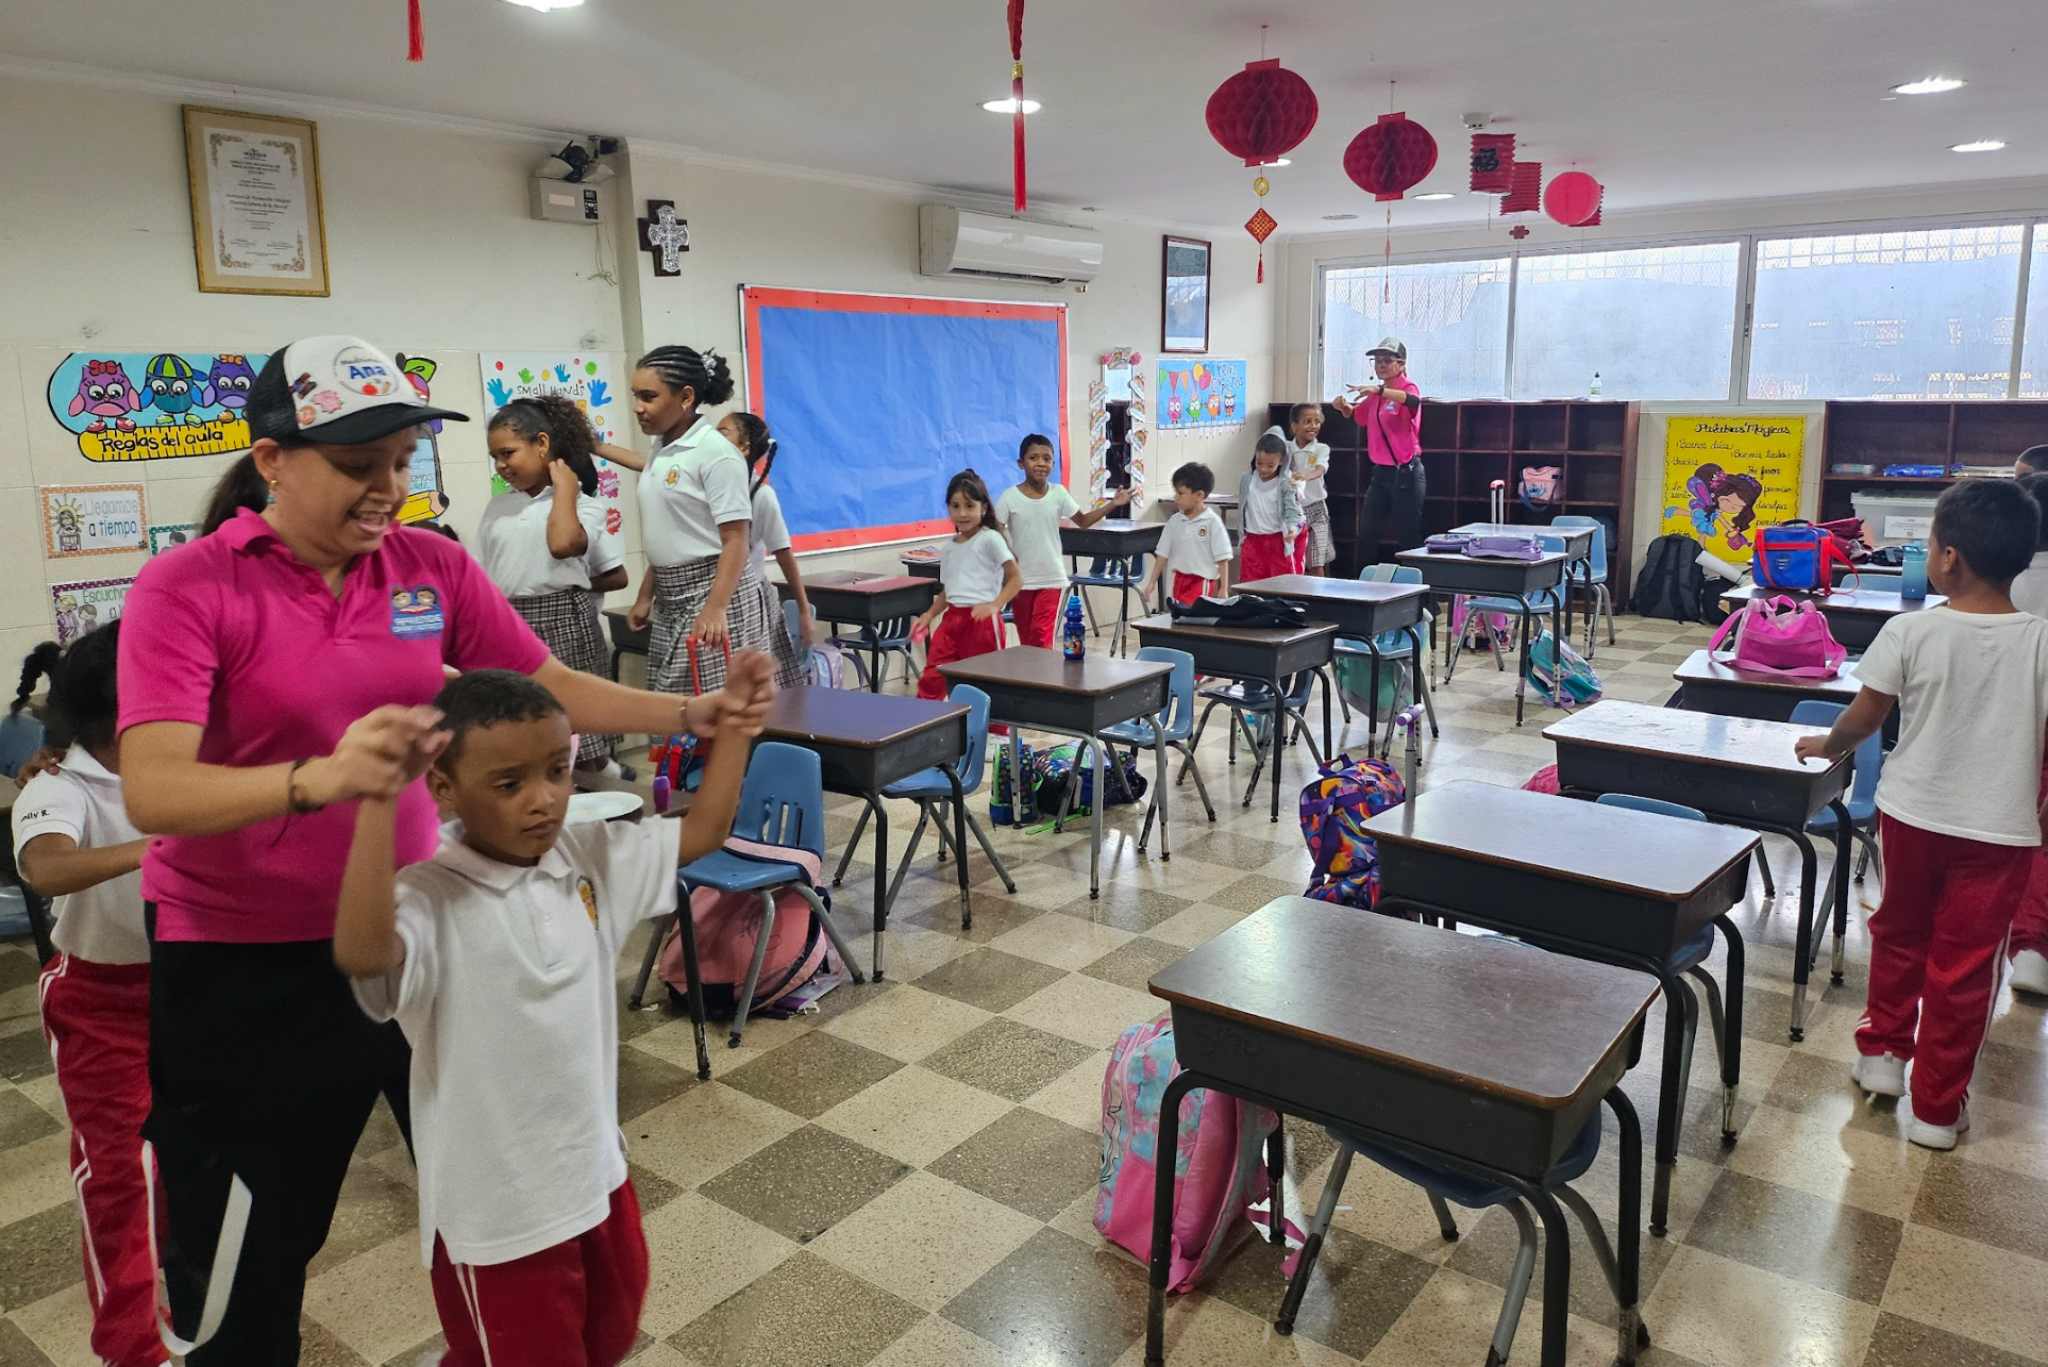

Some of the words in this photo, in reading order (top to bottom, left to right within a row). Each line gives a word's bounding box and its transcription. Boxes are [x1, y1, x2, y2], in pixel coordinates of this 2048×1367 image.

[350, 365, 386, 380] Ana
[1696, 422, 1745, 433] Palabras
[99, 433, 159, 452] Reglas
[161, 432, 180, 447] del
[185, 429, 223, 445] aula
[89, 522, 96, 537] a
